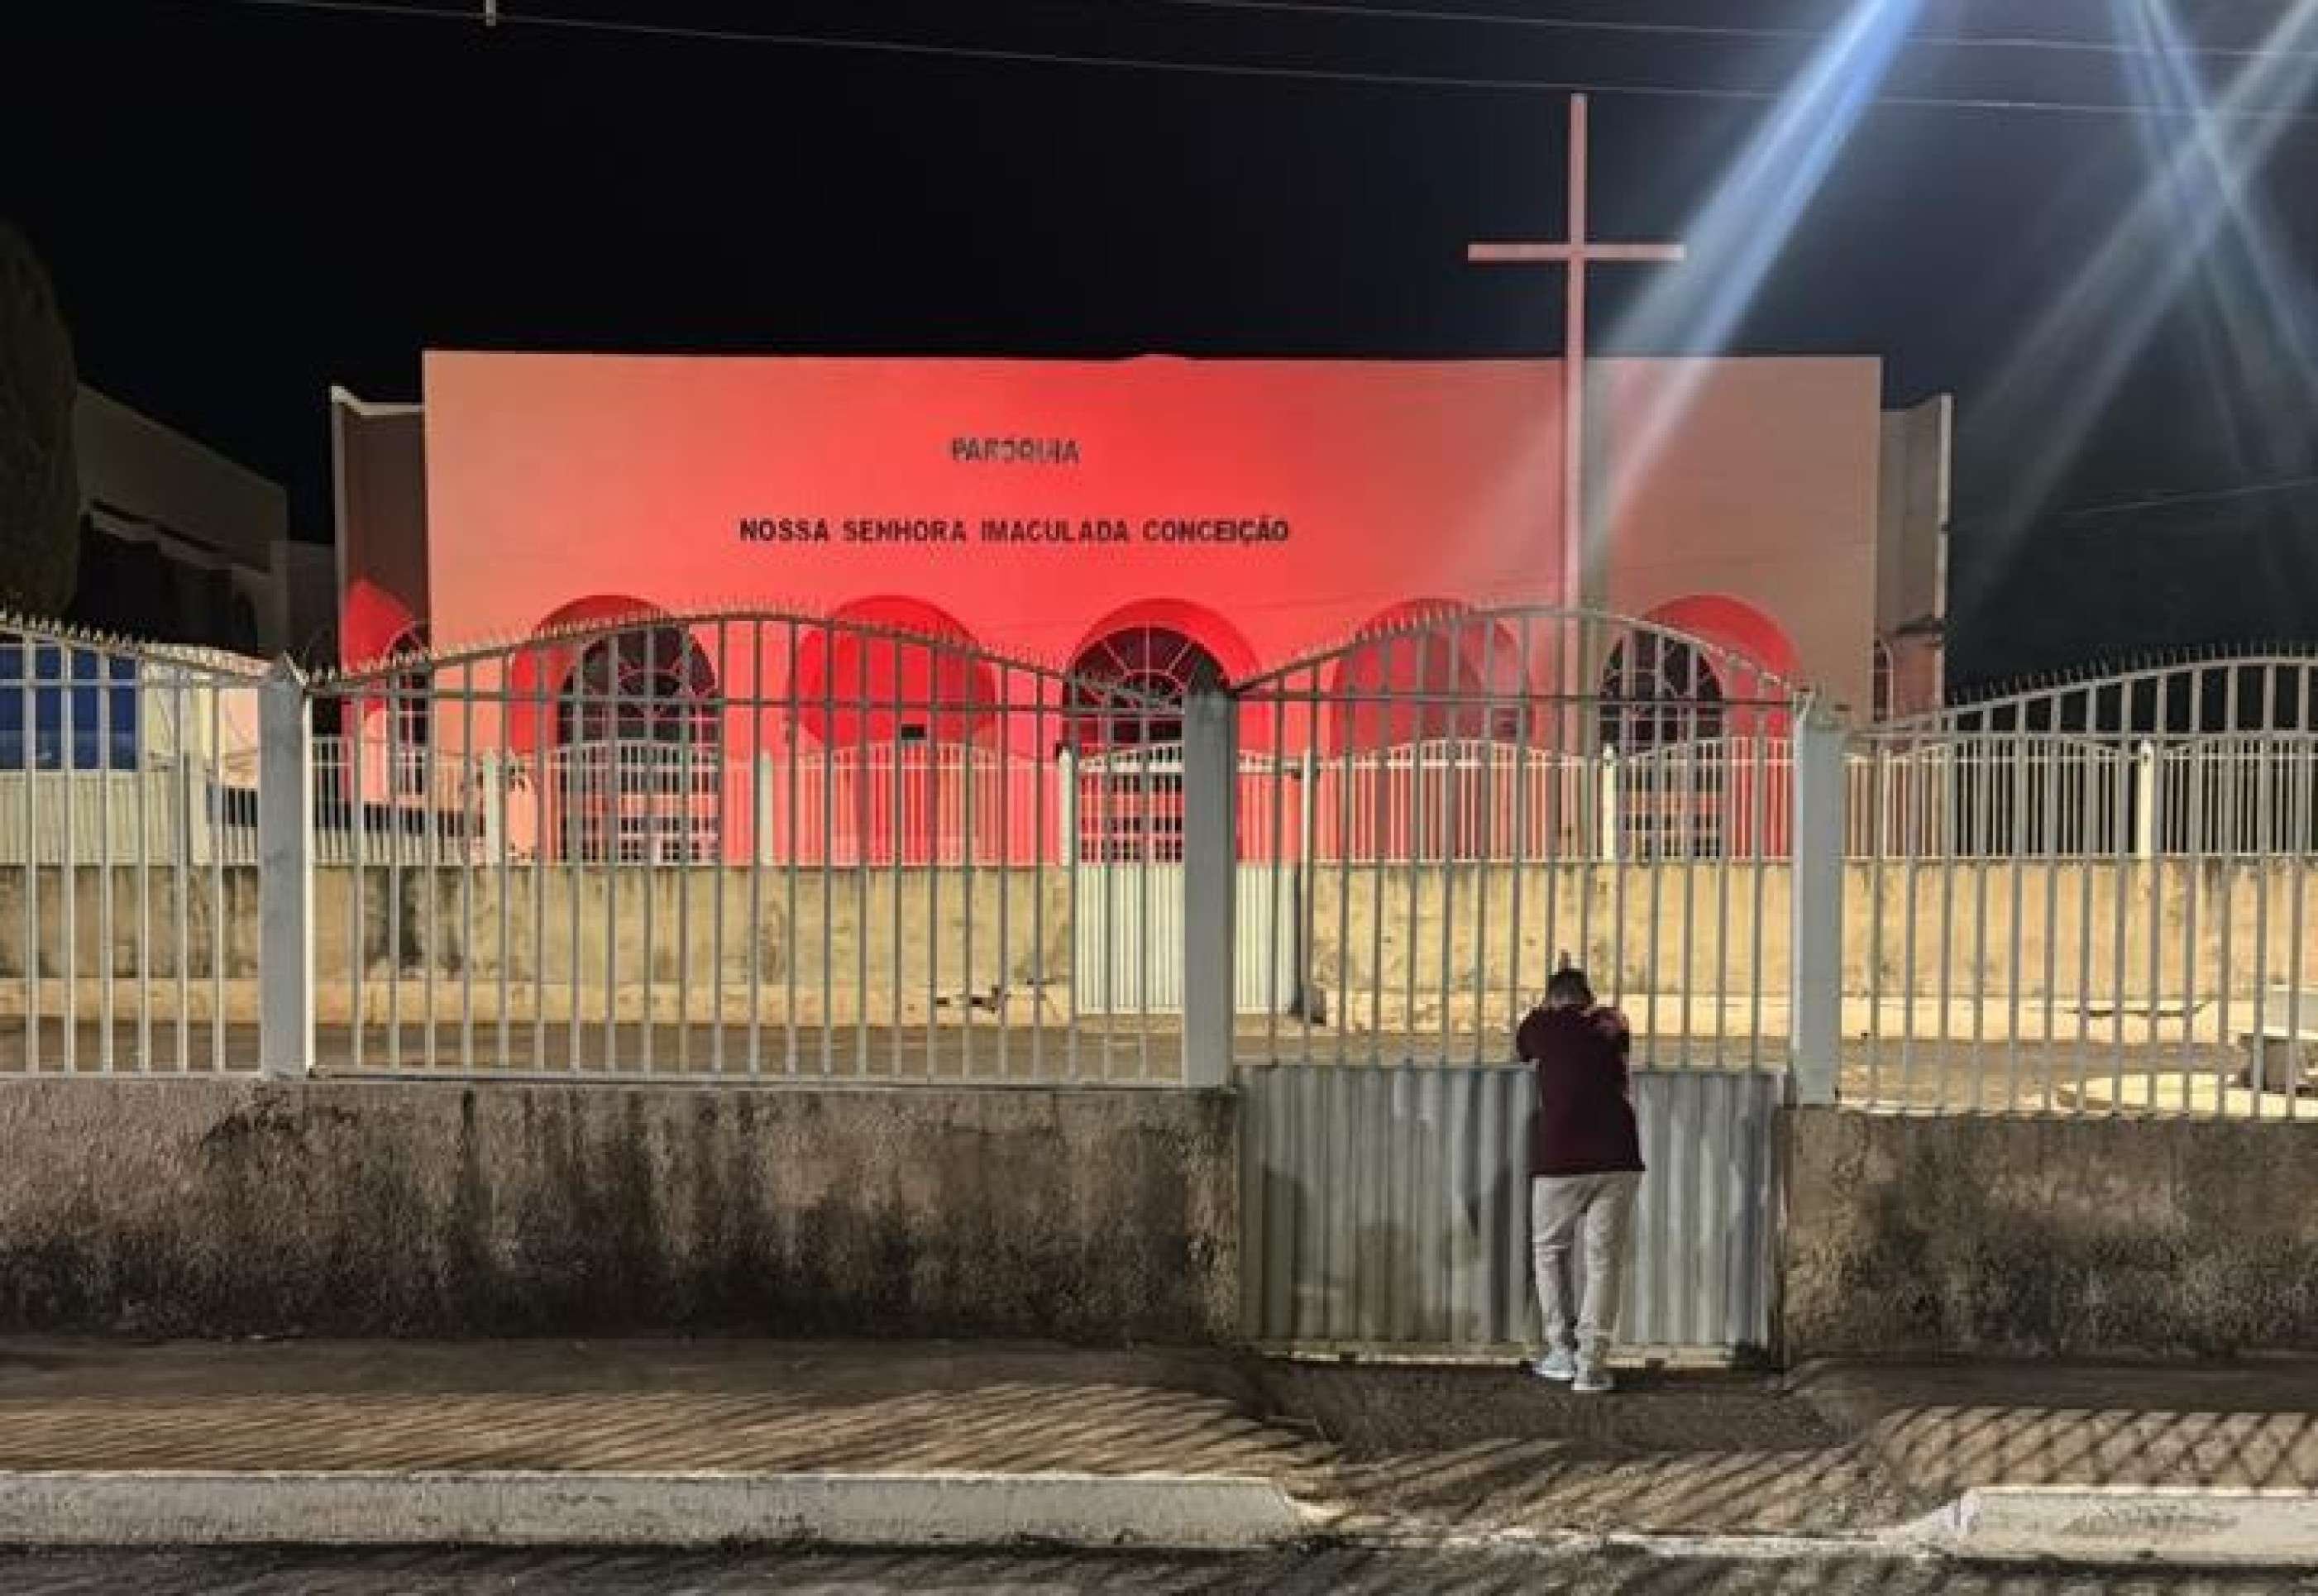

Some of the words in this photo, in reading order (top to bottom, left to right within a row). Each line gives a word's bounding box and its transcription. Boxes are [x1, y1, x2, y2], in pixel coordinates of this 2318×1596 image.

[739, 518, 829, 542] NOSSA
[843, 518, 966, 542] SENHORA
[981, 518, 1130, 542] IMACULADA
[1143, 515, 1289, 546] CONCEIÇÃO
